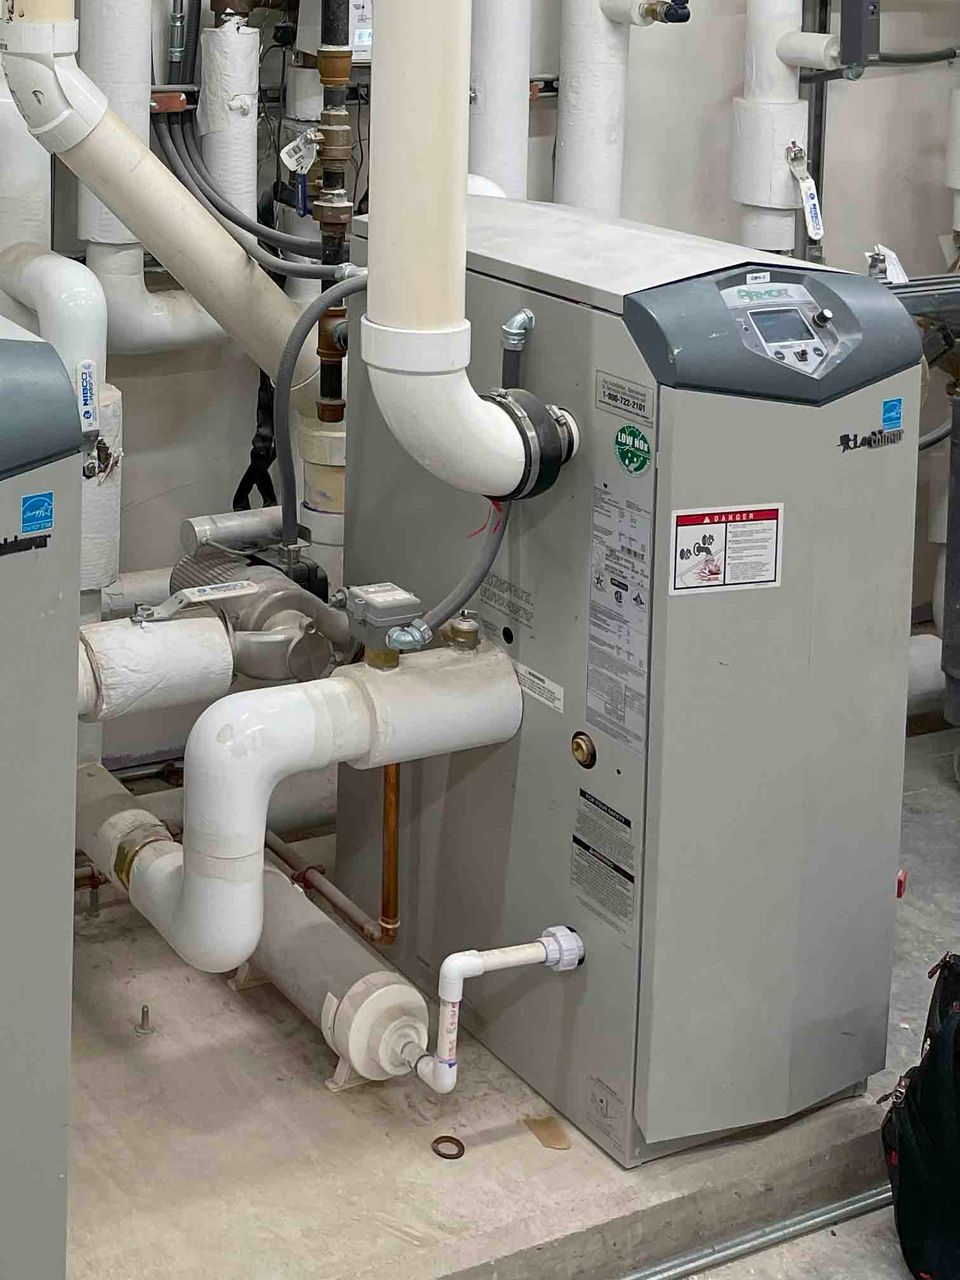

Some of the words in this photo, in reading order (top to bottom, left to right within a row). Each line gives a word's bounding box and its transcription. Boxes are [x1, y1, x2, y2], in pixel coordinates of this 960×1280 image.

[81, 372, 89, 407] NIBCO
[617, 432, 634, 446] LOW
[714, 512, 754, 523] DANGER
